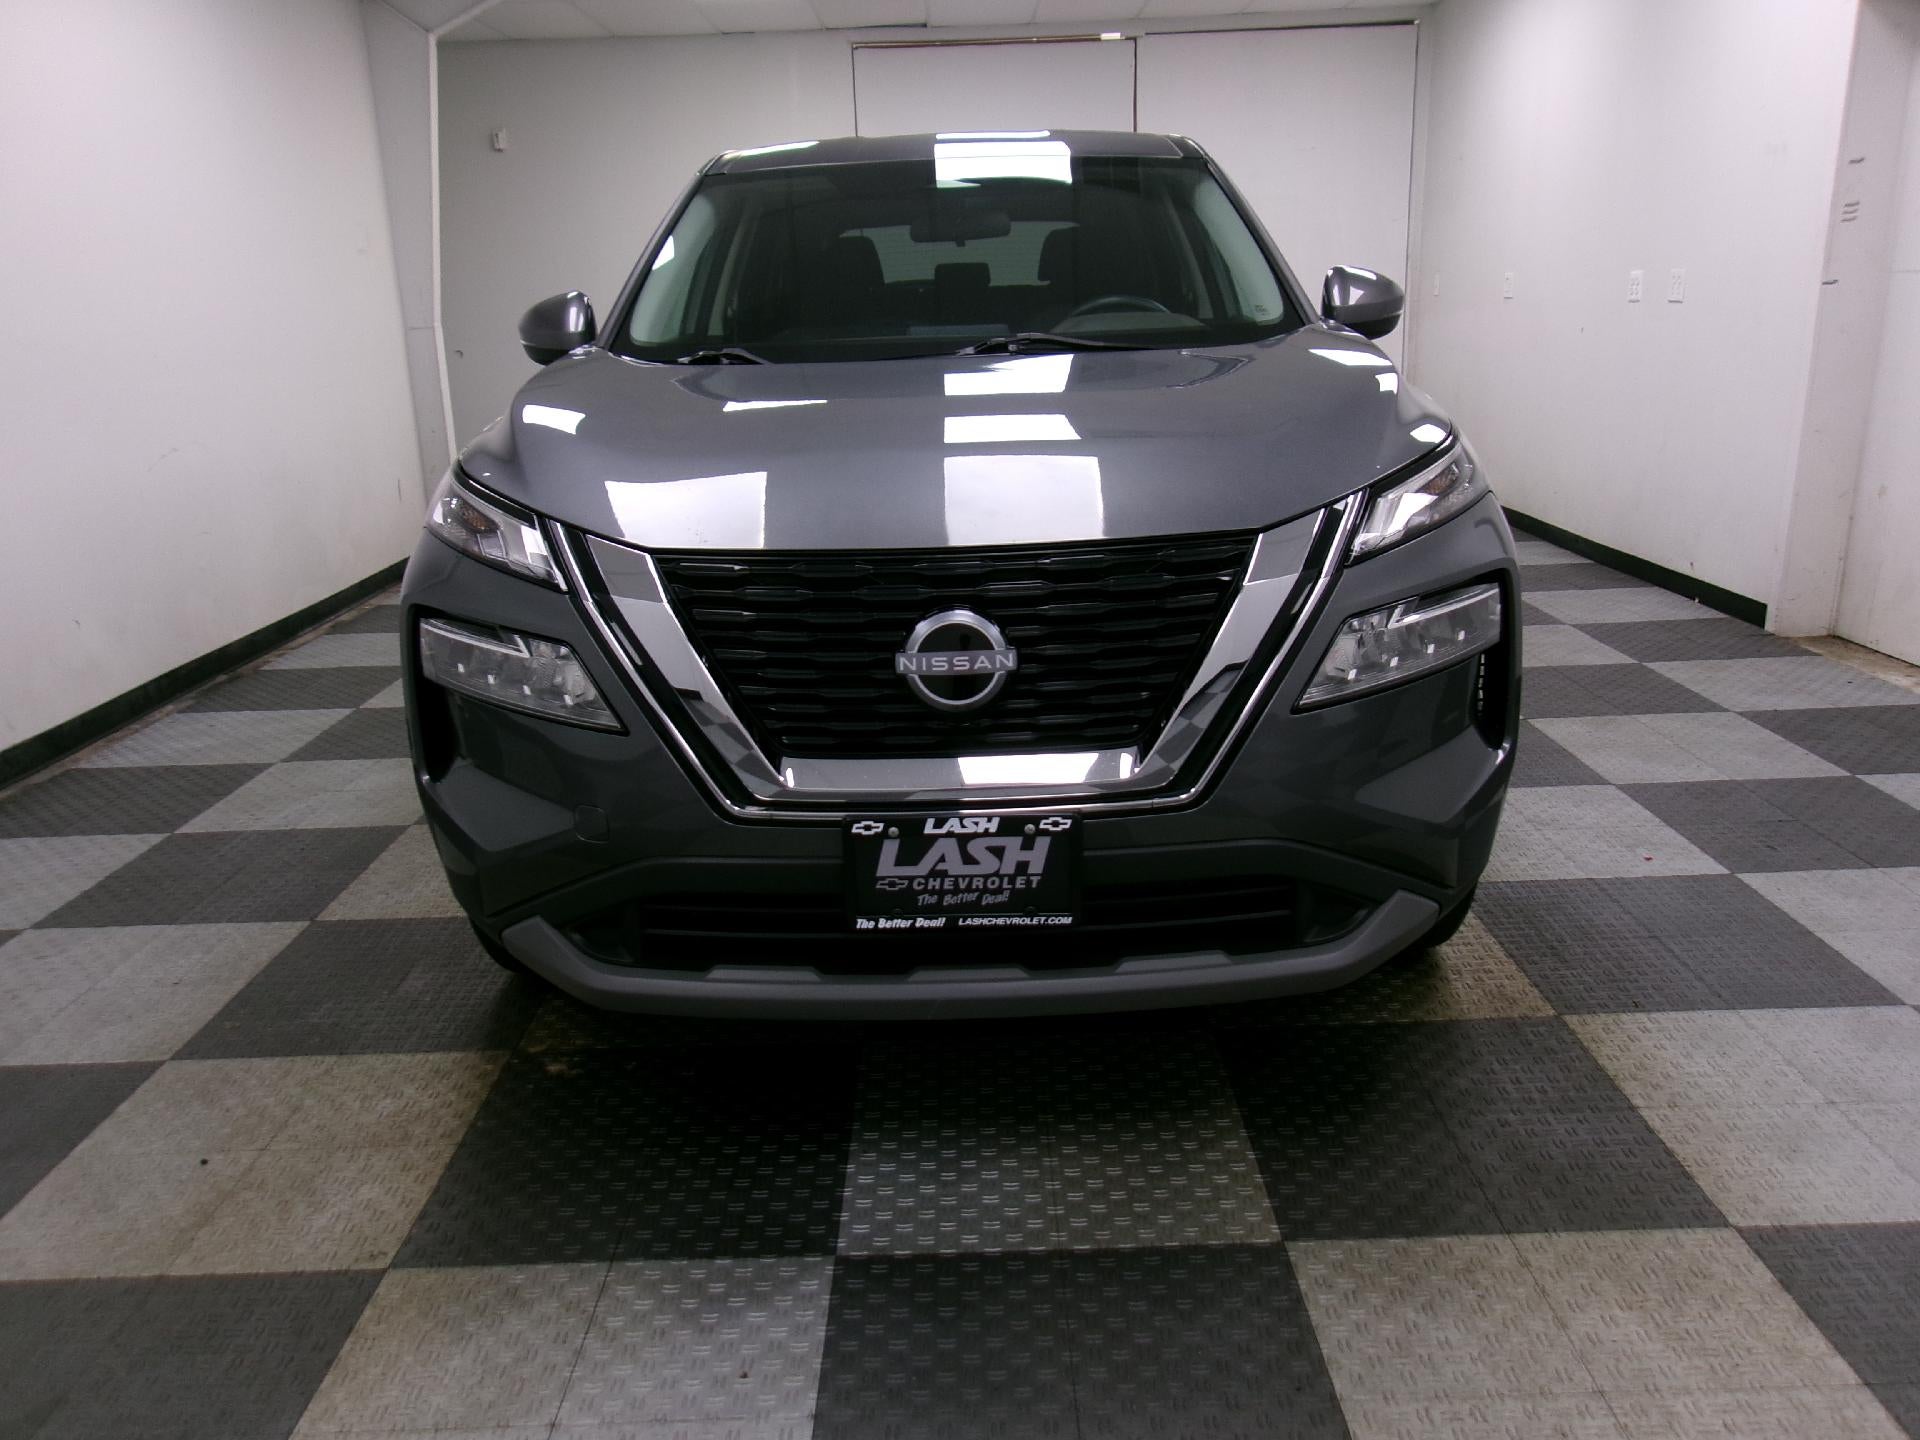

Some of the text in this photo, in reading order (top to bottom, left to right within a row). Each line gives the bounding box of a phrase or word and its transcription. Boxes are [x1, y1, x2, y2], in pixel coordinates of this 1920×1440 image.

[900, 653, 1014, 671] NISSAN
[923, 817, 1000, 834] LASH
[876, 836, 1052, 877] LASH
[912, 876, 1041, 890] CHEVROLET
[917, 894, 938, 906] The
[943, 892, 979, 906] Better
[856, 917, 947, 929] The Better Deal!
[958, 916, 1073, 926] LASHCHEVROLET.COM
